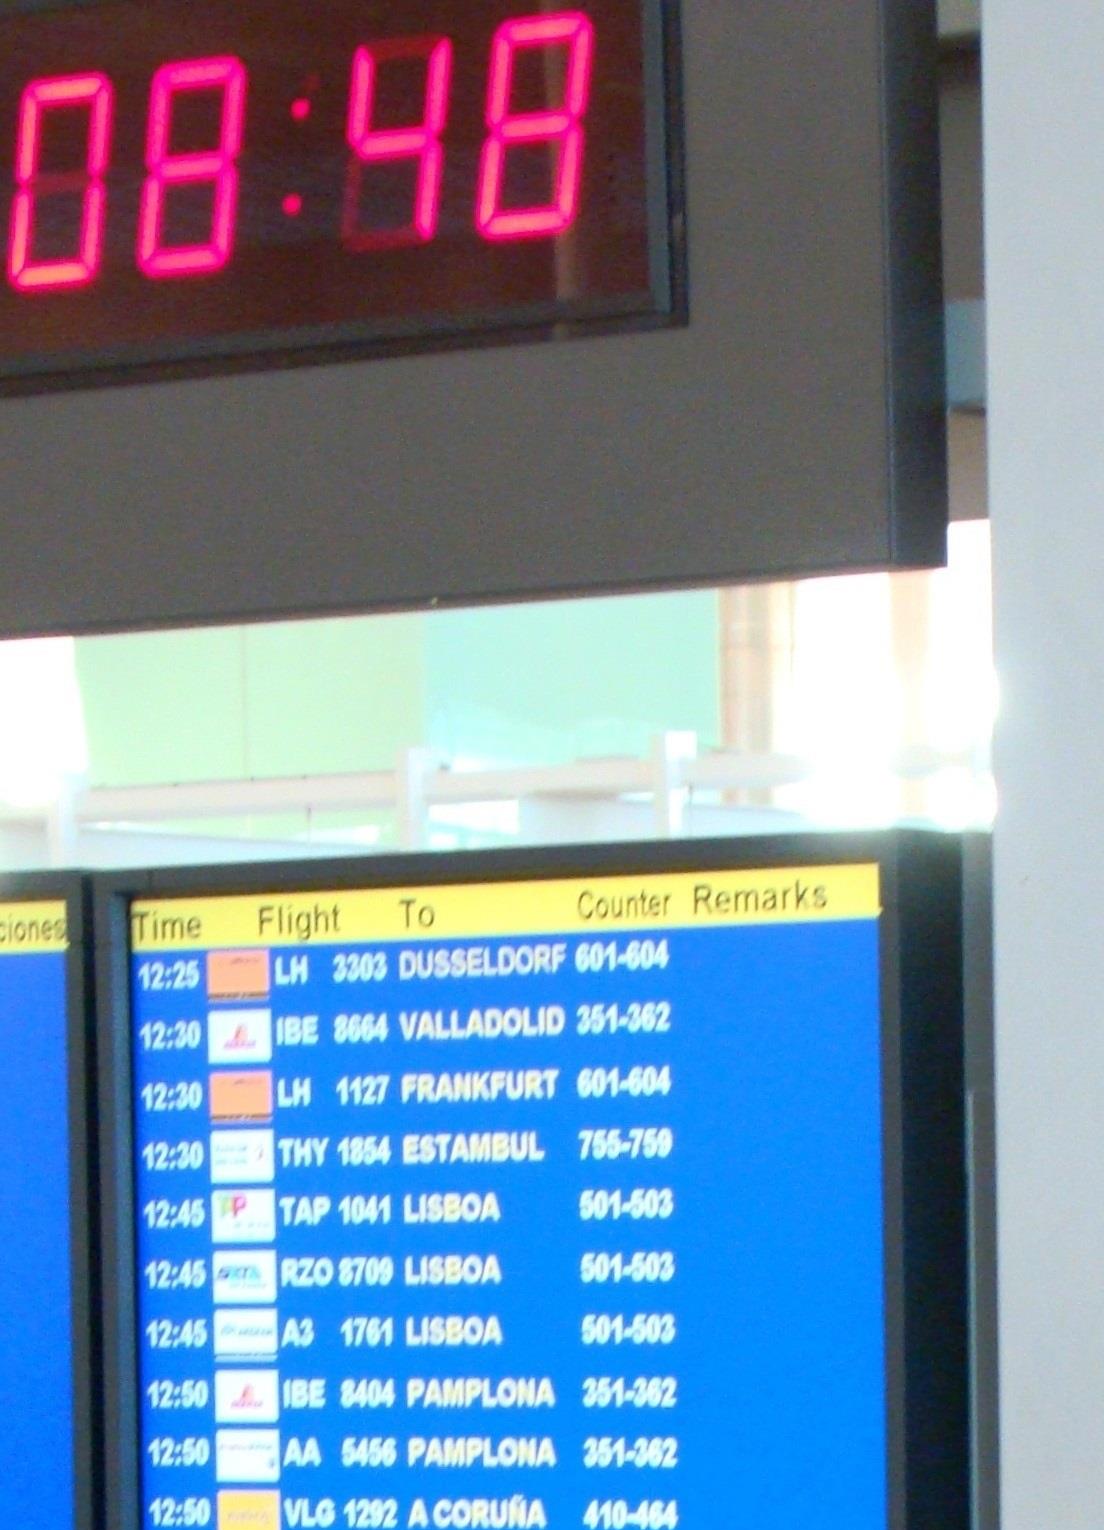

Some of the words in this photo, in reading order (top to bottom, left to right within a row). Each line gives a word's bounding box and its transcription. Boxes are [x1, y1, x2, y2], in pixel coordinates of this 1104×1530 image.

[132, 910, 202, 942] Time
[258, 904, 340, 940] Flight
[399, 900, 435, 929] To
[577, 888, 671, 920] Counter
[693, 880, 827, 915] Remarks
[139, 960, 200, 989] 12:25
[275, 955, 308, 984] LH
[334, 952, 388, 982] 3303
[399, 943, 566, 979] DUSSELDORF
[575, 939, 669, 972] 601-604
[140, 1020, 201, 1049] 12:30
[276, 1015, 318, 1045] IBE
[399, 1005, 565, 1040] VALLADOLID
[577, 1001, 671, 1034] 351-362
[142, 1081, 202, 1110] 12:30
[277, 1078, 311, 1107] LH
[336, 1075, 390, 1104] 1127
[401, 1068, 559, 1102] FRANKFURT
[577, 1065, 671, 1097] 601-604
[143, 1141, 204, 1169] 12:30
[278, 1137, 329, 1166] THY
[338, 1136, 391, 1165] 1854
[402, 1131, 545, 1164] ESTAMBUL
[579, 1127, 673, 1159] 755-759
[144, 1199, 205, 1227] 12:45
[279, 1196, 331, 1225] TAP
[339, 1195, 391, 1223] 1041
[404, 1192, 500, 1223] LISBOA
[580, 1188, 674, 1219] 501-503
[146, 1260, 206, 1287] 12:45
[281, 1257, 333, 1286] RZO
[338, 1256, 394, 1285] 8709
[405, 1254, 501, 1285] LISBOA
[581, 1252, 675, 1282] 501-503
[147, 1319, 206, 1347] 12:45
[282, 1318, 314, 1346] A3
[341, 1317, 393, 1345] 1761
[406, 1316, 502, 1345] LISBOA
[582, 1314, 675, 1343] 501-503
[148, 1380, 207, 1407] 12:50
[283, 1379, 325, 1408] IBE
[407, 1378, 555, 1407] PAMPLONA
[583, 1377, 677, 1407] 351-362
[149, 1438, 208, 1465] 12:50
[283, 1438, 321, 1466] AA
[408, 1437, 556, 1467] PAMPLONA
[584, 1437, 677, 1467] 351-362
[150, 1498, 209, 1525] 12:50
[283, 1498, 335, 1527] VLG
[344, 1499, 397, 1527] 1292
[408, 1500, 428, 1528] A
[432, 1495, 546, 1528] CORUÑA
[584, 1500, 678, 1529] 410-464
